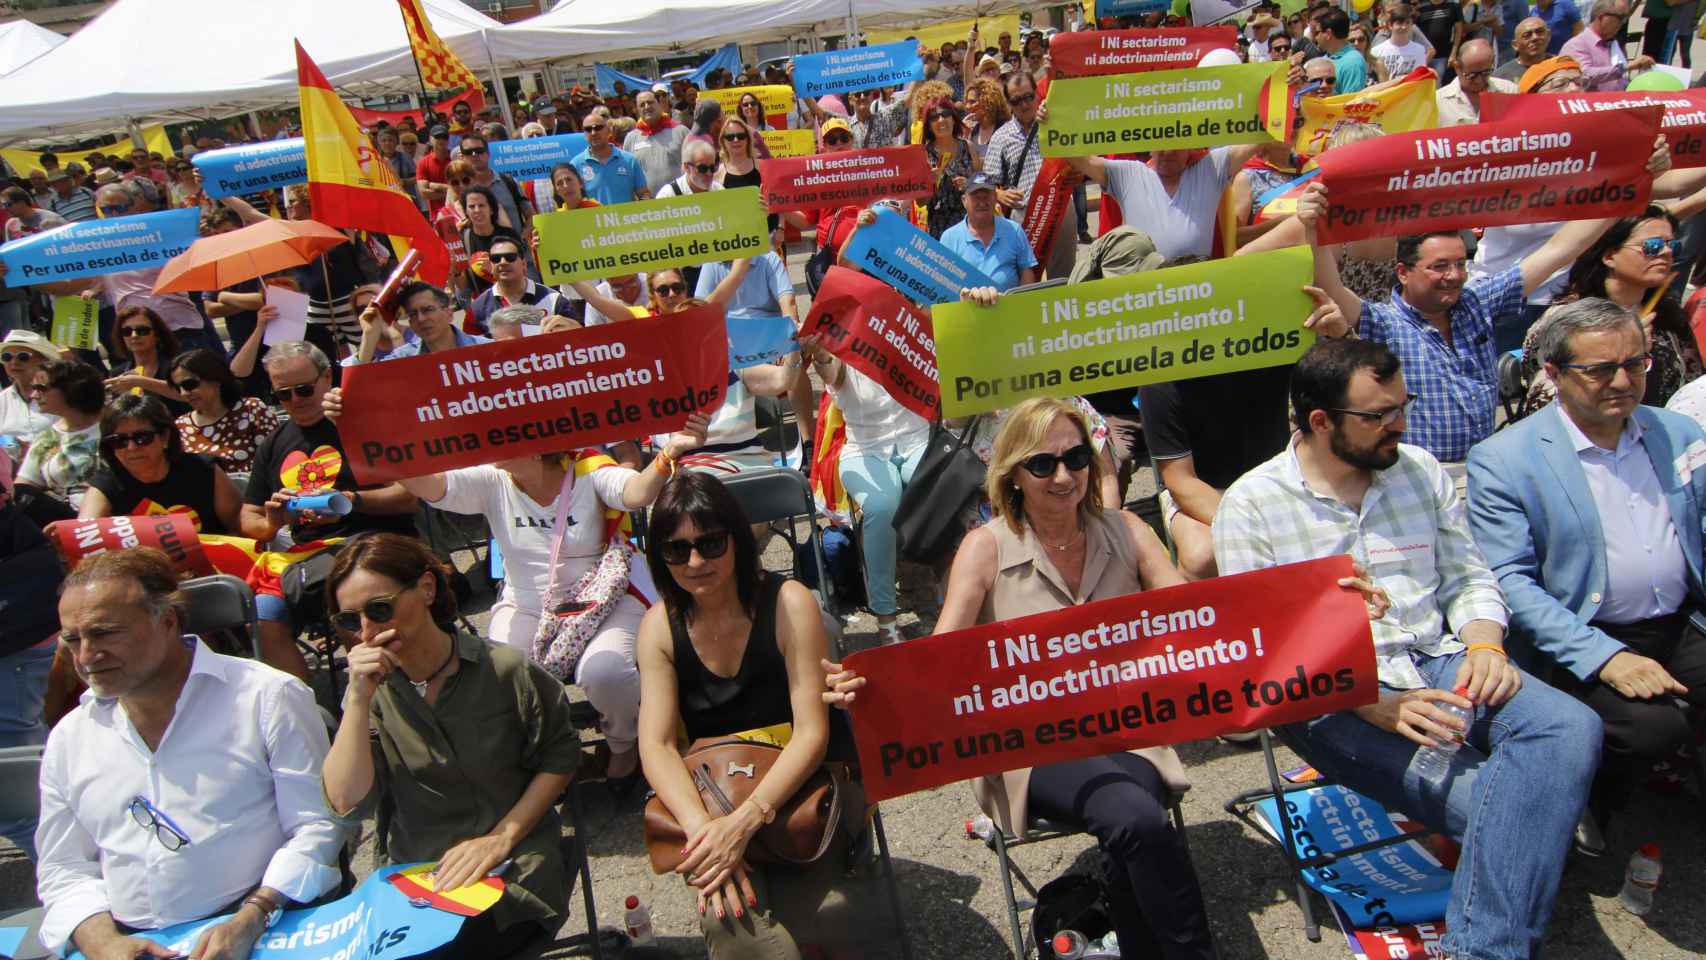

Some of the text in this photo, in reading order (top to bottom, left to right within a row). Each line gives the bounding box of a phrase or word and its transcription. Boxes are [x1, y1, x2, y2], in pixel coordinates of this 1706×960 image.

[1122, 36, 1186, 48] sectarismo
[1085, 53, 1096, 65] ni
[807, 70, 912, 92] Per una escola de tots
[1134, 77, 1221, 96] sectarismo
[1085, 105, 1099, 121] ni
[1048, 129, 1077, 147] Por
[1083, 128, 1115, 145] una
[1121, 120, 1192, 141] escuela
[1197, 117, 1220, 136] de
[1675, 133, 1702, 153] de
[1456, 131, 1571, 158] sectarismo
[826, 155, 884, 169] sectarismo
[219, 179, 240, 192] Per
[245, 176, 269, 186] una
[794, 178, 804, 186] ni
[1387, 170, 1409, 192] ni
[768, 181, 927, 205] Por una escuela de todos
[1327, 180, 1636, 228] Por una escuela de todos
[623, 204, 701, 225] sectarismo
[76, 222, 146, 237] sectarisme
[44, 246, 57, 256] ni
[580, 235, 594, 249] ni
[22, 264, 50, 277] Per
[56, 261, 85, 274] una
[89, 251, 137, 269] escola
[141, 249, 159, 262] de
[549, 233, 760, 275] Por una escuela de todos
[865, 247, 888, 269] Per
[888, 266, 906, 282] una
[907, 276, 939, 301] escola
[1085, 282, 1213, 319] sectarismo
[868, 315, 887, 336] ni
[816, 312, 848, 342] Por
[852, 337, 889, 370] una
[1011, 336, 1034, 359] ni
[490, 342, 626, 380] sectarismo
[955, 327, 1300, 402] Por una escuela de todos
[416, 398, 439, 422] ni
[362, 383, 719, 467] Por una escuela de todos
[1047, 606, 1216, 659] sectarismo
[953, 685, 984, 716] ni
[880, 664, 1356, 777] Por una escuela de todos
